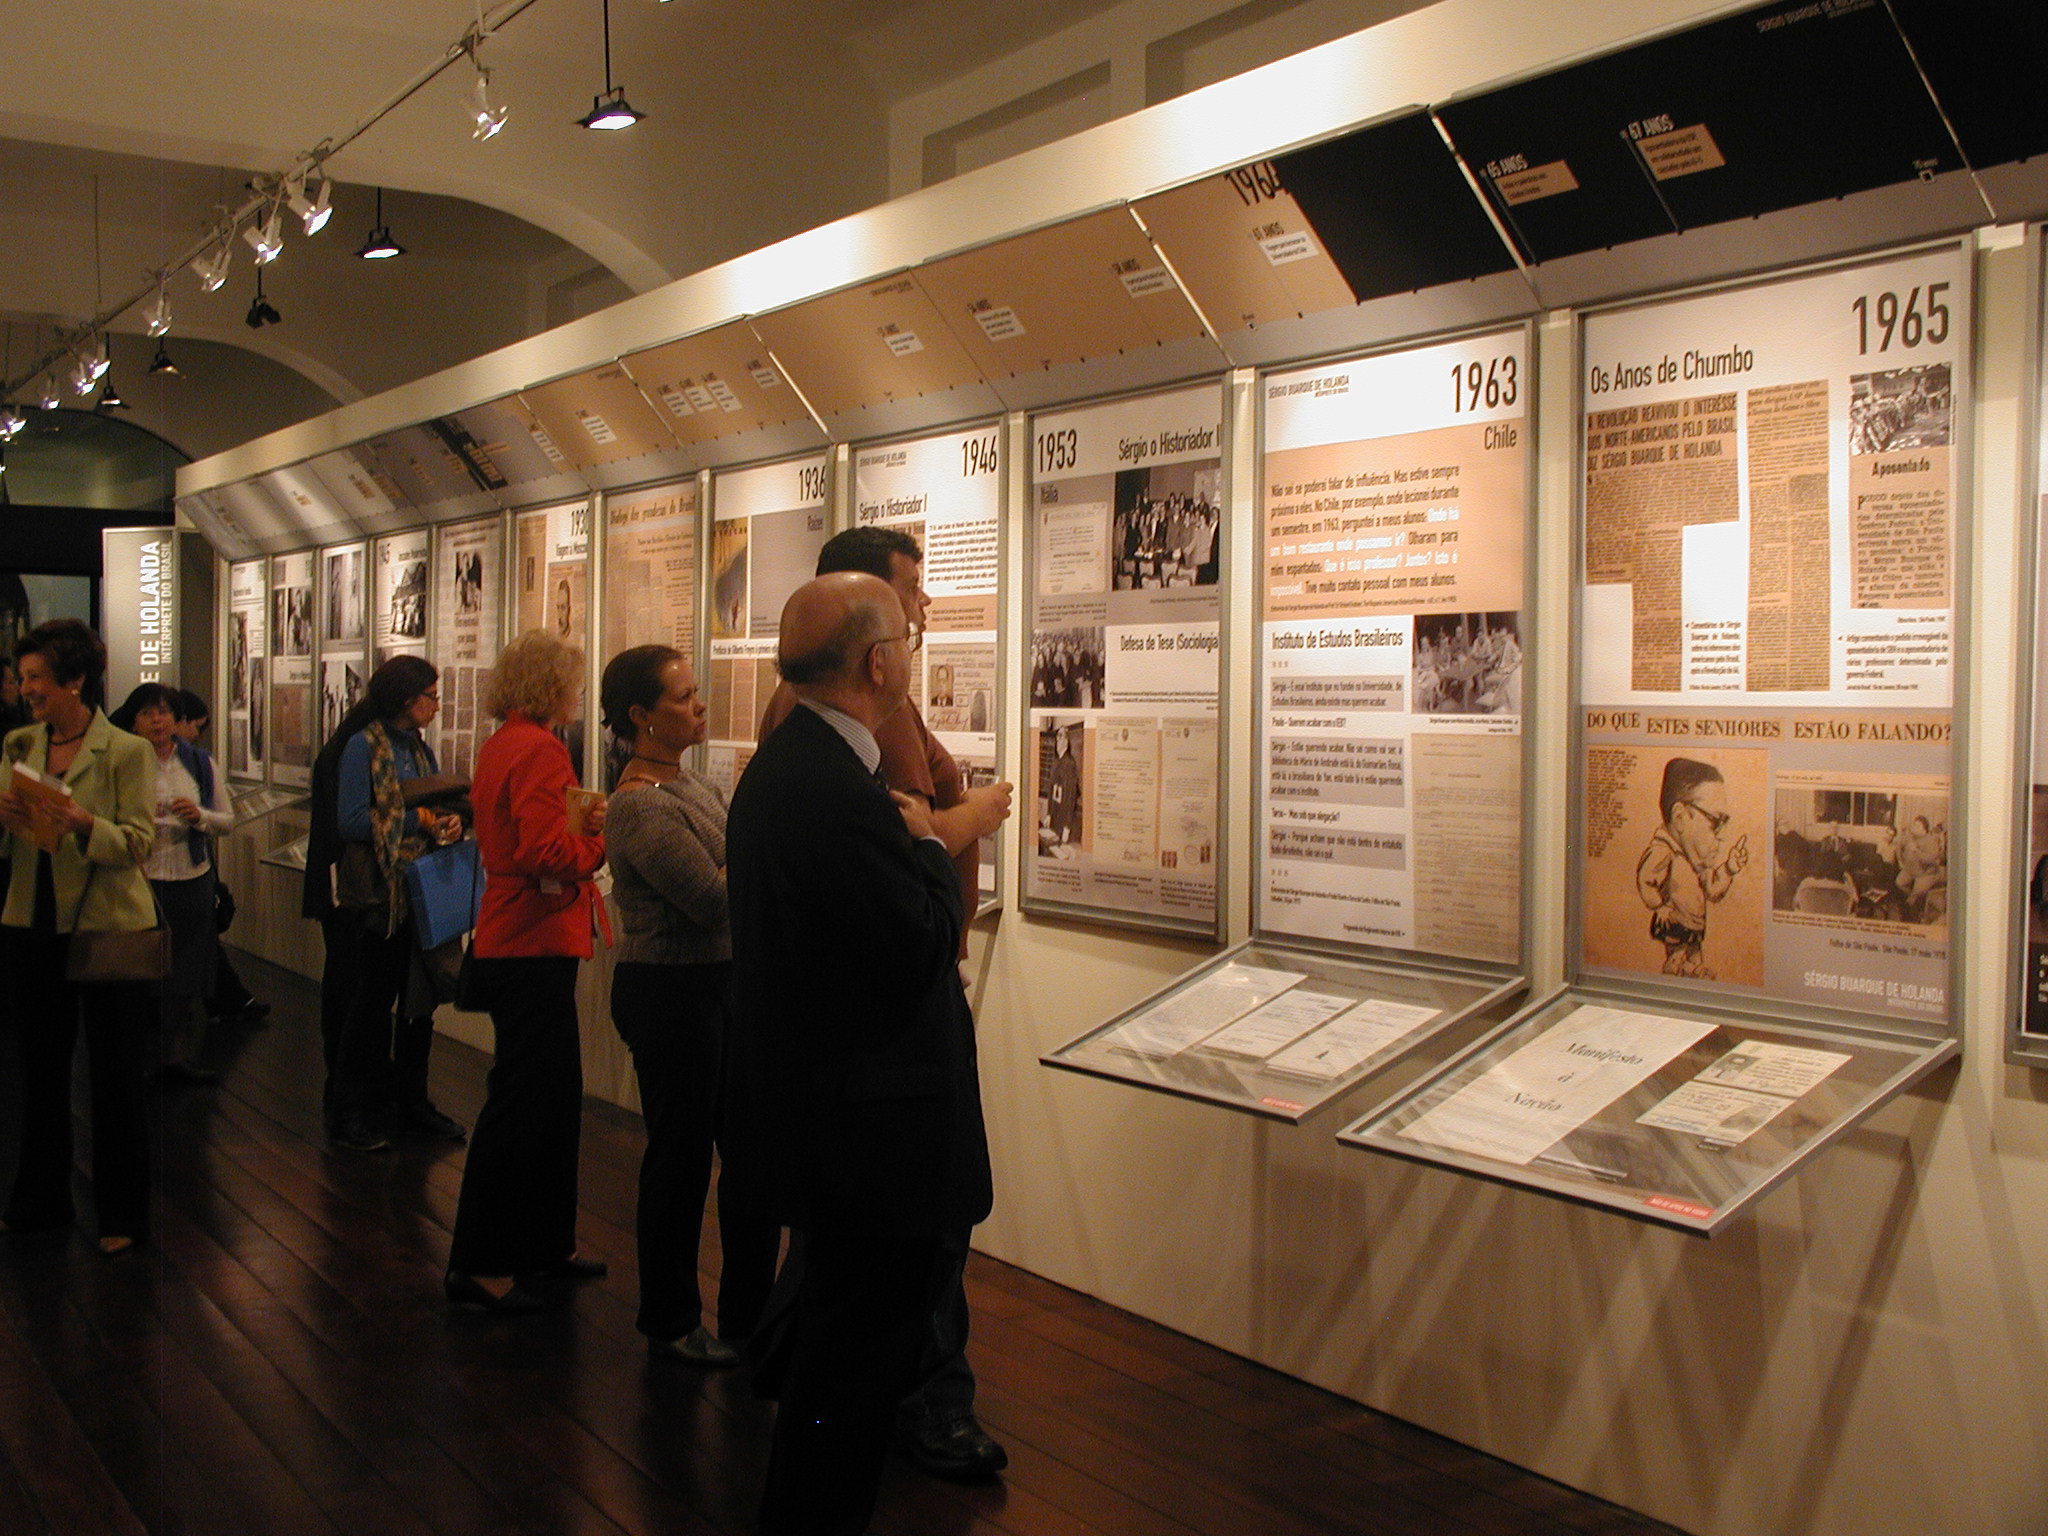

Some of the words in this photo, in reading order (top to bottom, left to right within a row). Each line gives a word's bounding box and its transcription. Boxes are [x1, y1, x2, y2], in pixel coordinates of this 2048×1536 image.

[1628, 121, 1643, 140] 67
[1642, 113, 1675, 136] ANOS
[1500, 153, 1529, 175] ANOS
[1852, 282, 1950, 356] 1965
[1452, 355, 1516, 413] 1963
[1591, 366, 1609, 394] Os
[1614, 360, 1653, 392] Anos
[1657, 353, 1678, 383] de
[1683, 345, 1754, 381] Chumbo
[1682, 401, 1690, 417] O
[1118, 435, 1147, 464] Sérgio
[1150, 440, 1157, 456] o
[1159, 423, 1213, 456] Historiador
[1484, 424, 1517, 450] Chile
[1682, 420, 1703, 438] PELO
[962, 435, 997, 477] 1946
[1038, 428, 1077, 473] 1953
[1630, 445, 1664, 465] BUARQUE
[1668, 444, 1680, 460] DE
[1684, 440, 1722, 459] HOLANDA
[1272, 485, 1283, 497] Não
[1285, 485, 1294, 496] sei
[1295, 484, 1302, 495] se
[1304, 480, 1327, 497] poderei
[1328, 477, 1343, 490] falar
[1346, 478, 1354, 489] de
[1394, 469, 1408, 482] Mas
[1410, 467, 1429, 481] estive
[1431, 465, 1459, 480] sempre
[1872, 456, 1931, 478] Aposentado
[799, 465, 826, 501] 1936
[859, 500, 879, 525] Sérgio
[881, 504, 886, 517] o
[886, 494, 923, 518] Historiador
[1342, 499, 1353, 514] por
[1386, 490, 1403, 505] onde
[1431, 485, 1459, 500] durante
[1312, 522, 1321, 533] em
[1342, 514, 1375, 533] perguntei
[1376, 517, 1380, 527] a
[1382, 515, 1401, 526] meus
[1409, 530, 1437, 545] Olharam
[1441, 531, 1458, 546] para
[161, 542, 174, 580] BRASIL
[140, 541, 160, 635] HOLANDA
[161, 584, 173, 597] DO
[1362, 575, 1390, 593] pessoal
[1392, 578, 1407, 588] com
[1409, 577, 1429, 587] meus
[161, 600, 173, 664] INTÉRPRETE
[1120, 635, 1144, 652] Defesa
[1146, 634, 1155, 651] de
[1157, 633, 1174, 652] Tese
[1272, 631, 1304, 649] Instituto
[1306, 631, 1317, 648] de
[1319, 630, 1352, 648] Estudos
[1354, 628, 1403, 648] Brasileiros
[141, 639, 160, 666] DE
[1587, 712, 1607, 729] DO
[1611, 712, 1641, 732] QUE
[1647, 718, 1690, 735] ESTES
[1695, 719, 1781, 738] SENHORES
[1794, 718, 1850, 740] ESTÃO
[1857, 721, 1951, 742] FALANDO?
[1804, 970, 1839, 990] SÉRGIO
[1839, 976, 1885, 996] BUARQUE
[1886, 981, 1899, 997] DE
[1901, 983, 1945, 1003] HOLANDA
